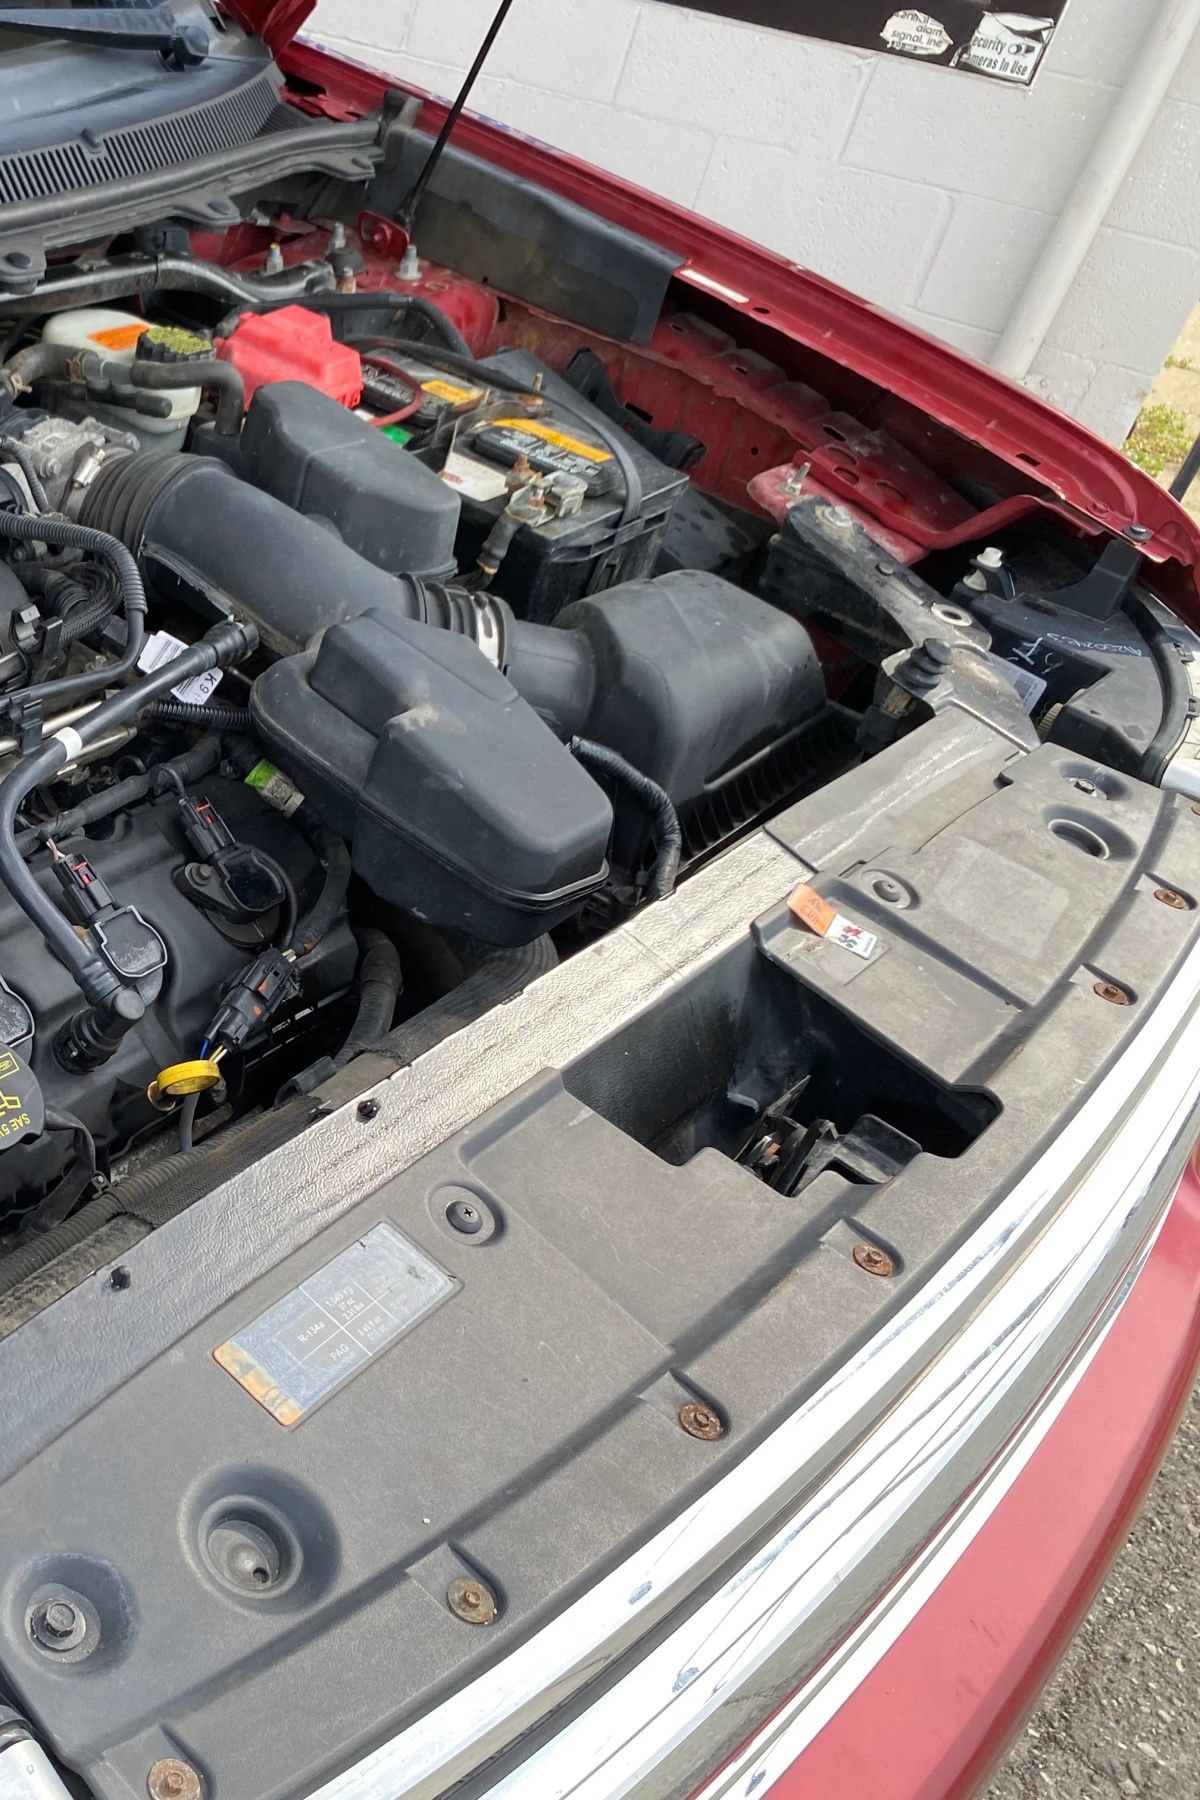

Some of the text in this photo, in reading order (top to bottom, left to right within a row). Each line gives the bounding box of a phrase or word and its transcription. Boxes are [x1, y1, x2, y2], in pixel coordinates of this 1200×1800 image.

[972, 36, 1007, 55] ecurity
[971, 54, 1028, 76] meras In Use
[9, 1113, 30, 1131] SAE
[297, 1321, 326, 1343] R-134a
[330, 1343, 350, 1361] PAG
